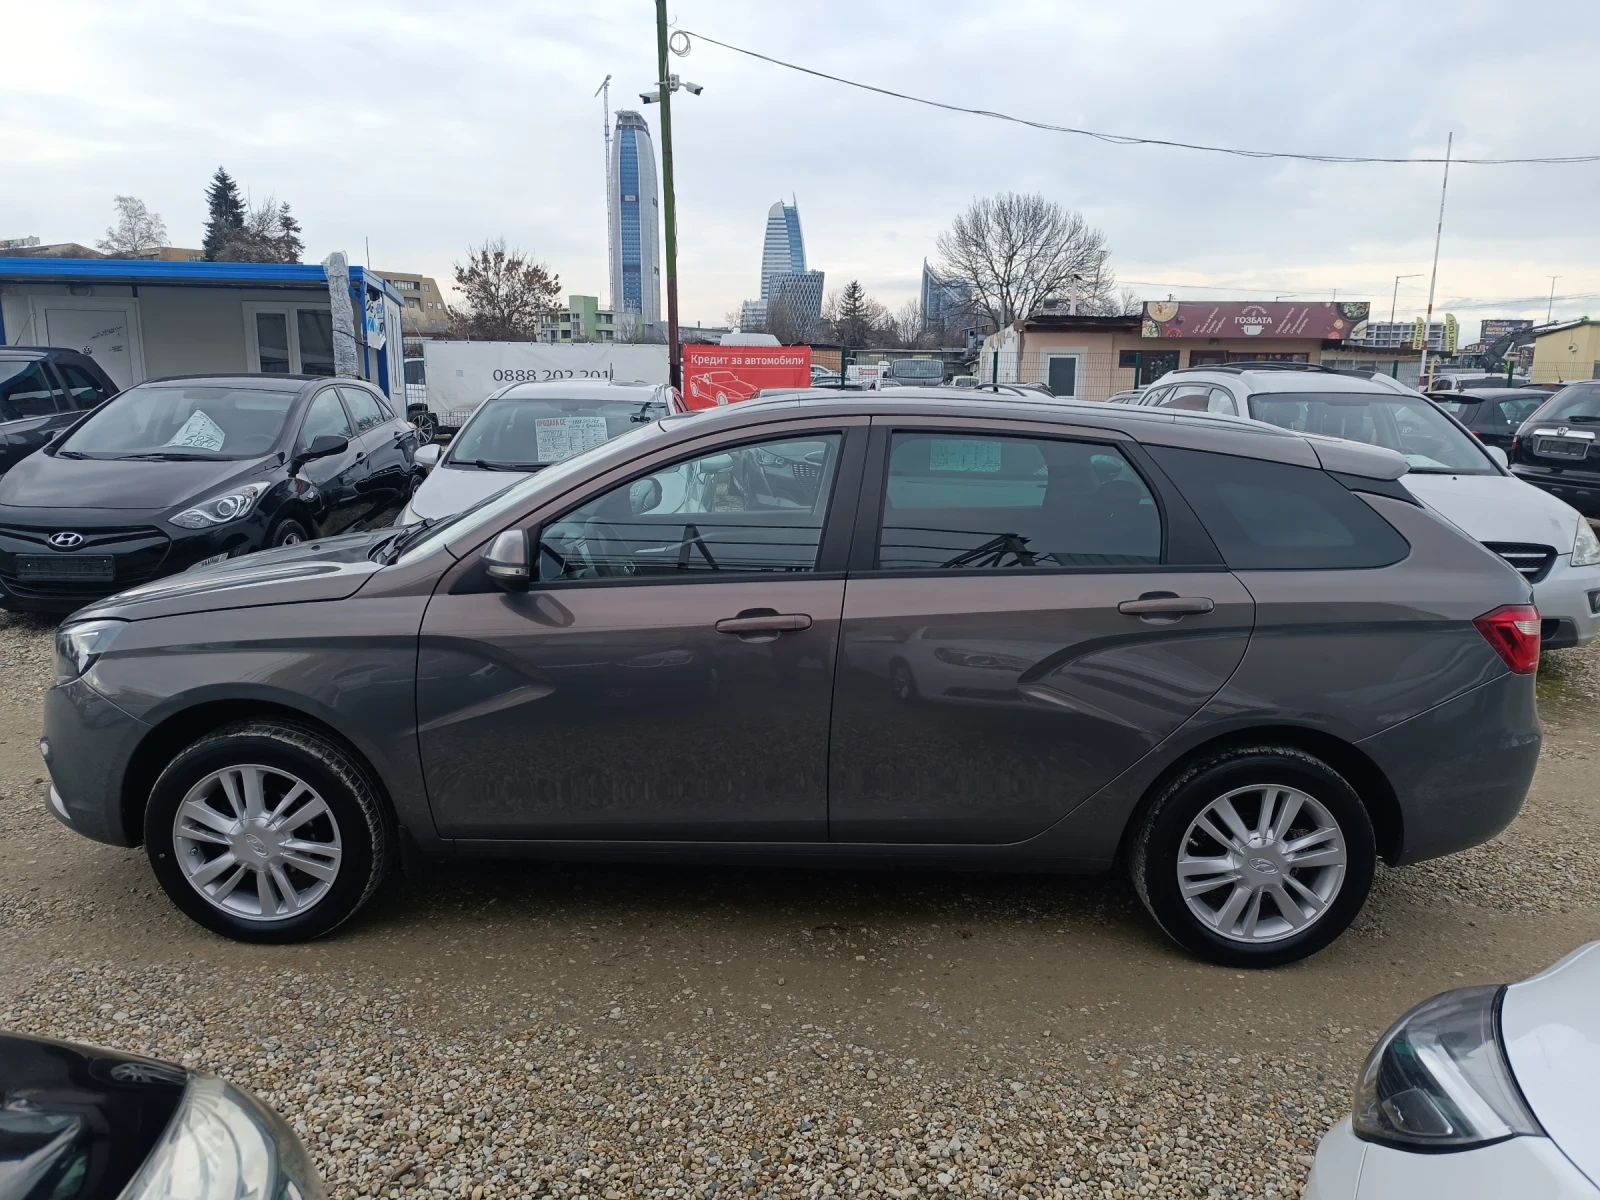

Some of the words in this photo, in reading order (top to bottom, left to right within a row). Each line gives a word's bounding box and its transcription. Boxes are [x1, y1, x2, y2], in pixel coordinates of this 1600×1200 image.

[1234, 316, 1273, 324] ГОЗБАТА
[690, 354, 729, 366] Кредит
[731, 356, 742, 365] за
[744, 356, 804, 366] автомобили
[492, 369, 537, 381] 0888
[560, 418, 566, 426] СЕ
